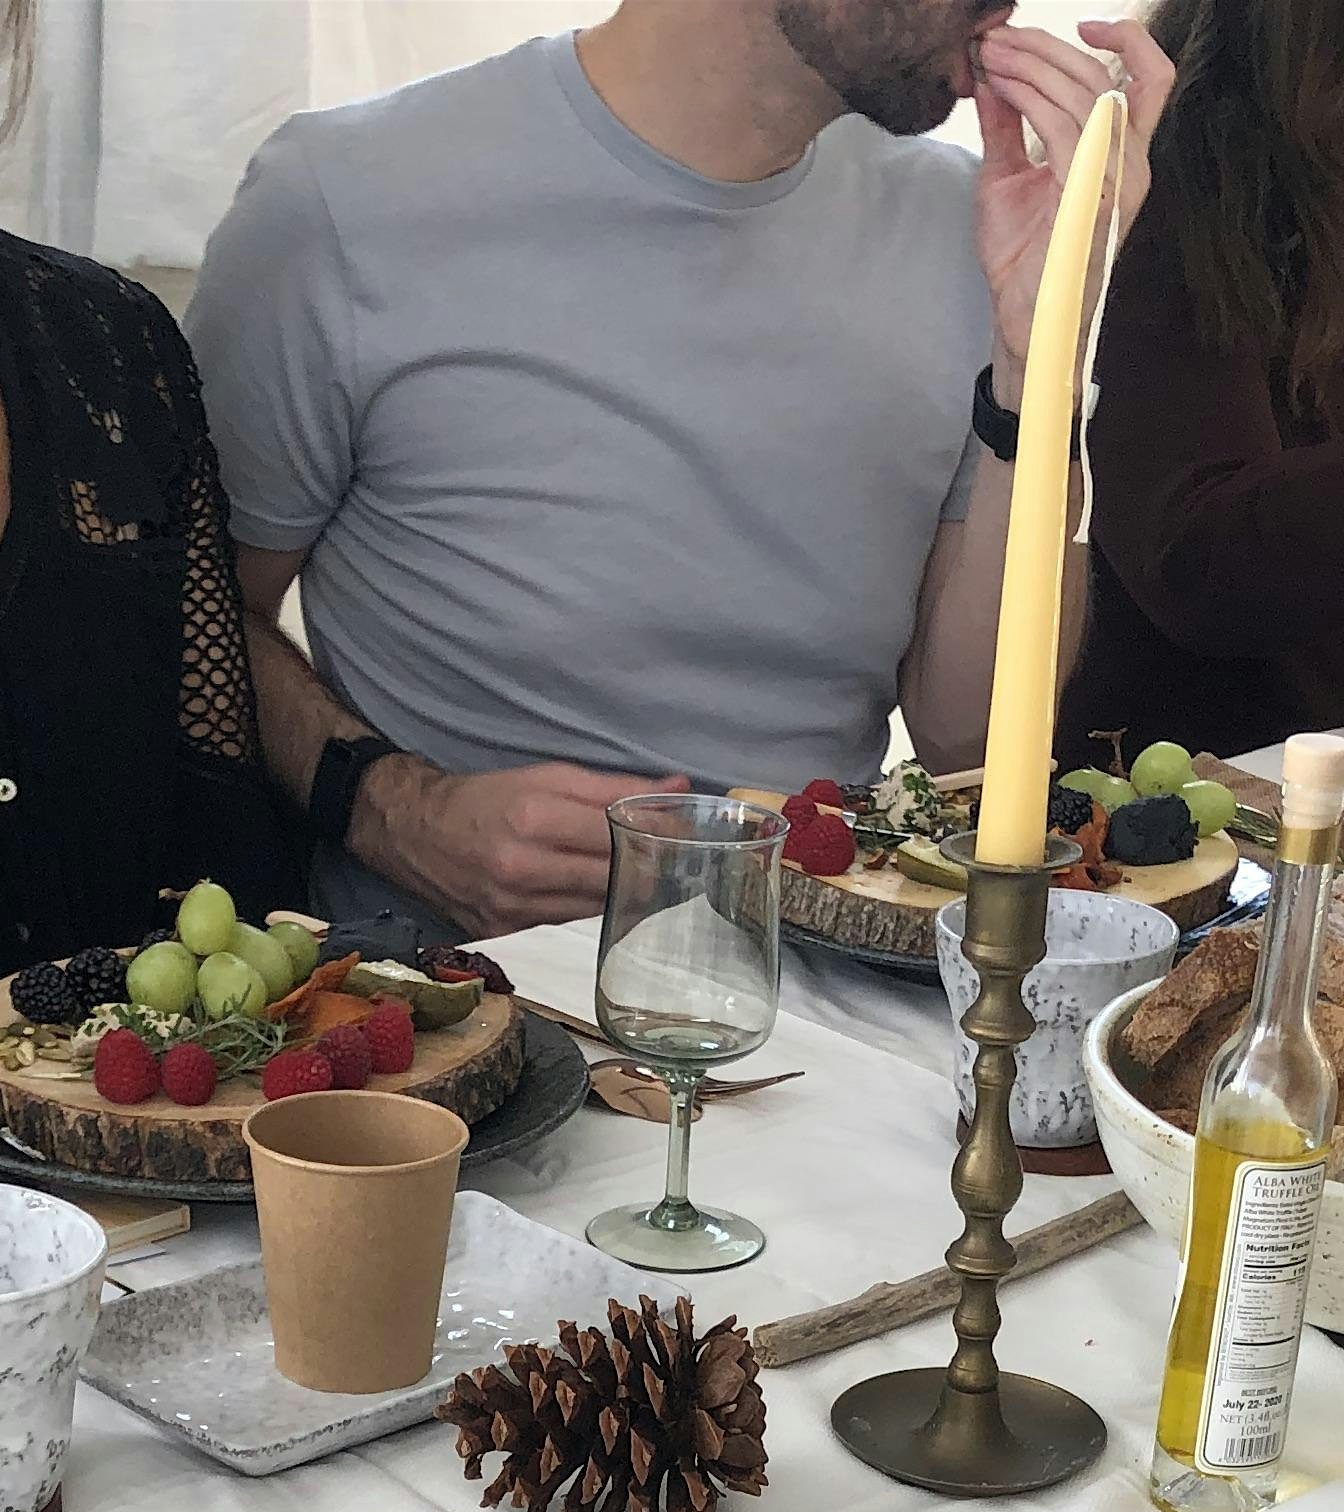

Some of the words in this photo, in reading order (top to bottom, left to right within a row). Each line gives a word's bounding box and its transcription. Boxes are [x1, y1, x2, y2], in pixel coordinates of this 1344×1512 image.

[1253, 1176, 1286, 1187] ALBA
[1253, 1186, 1304, 1199] TRUFFLE
[1246, 1243, 1290, 1253] Nutrition
[1242, 1272, 1276, 1280] Calories
[1223, 1399, 1245, 1412] July
[1220, 1414, 1243, 1424] NET
[1241, 1422, 1271, 1437] 100ml
